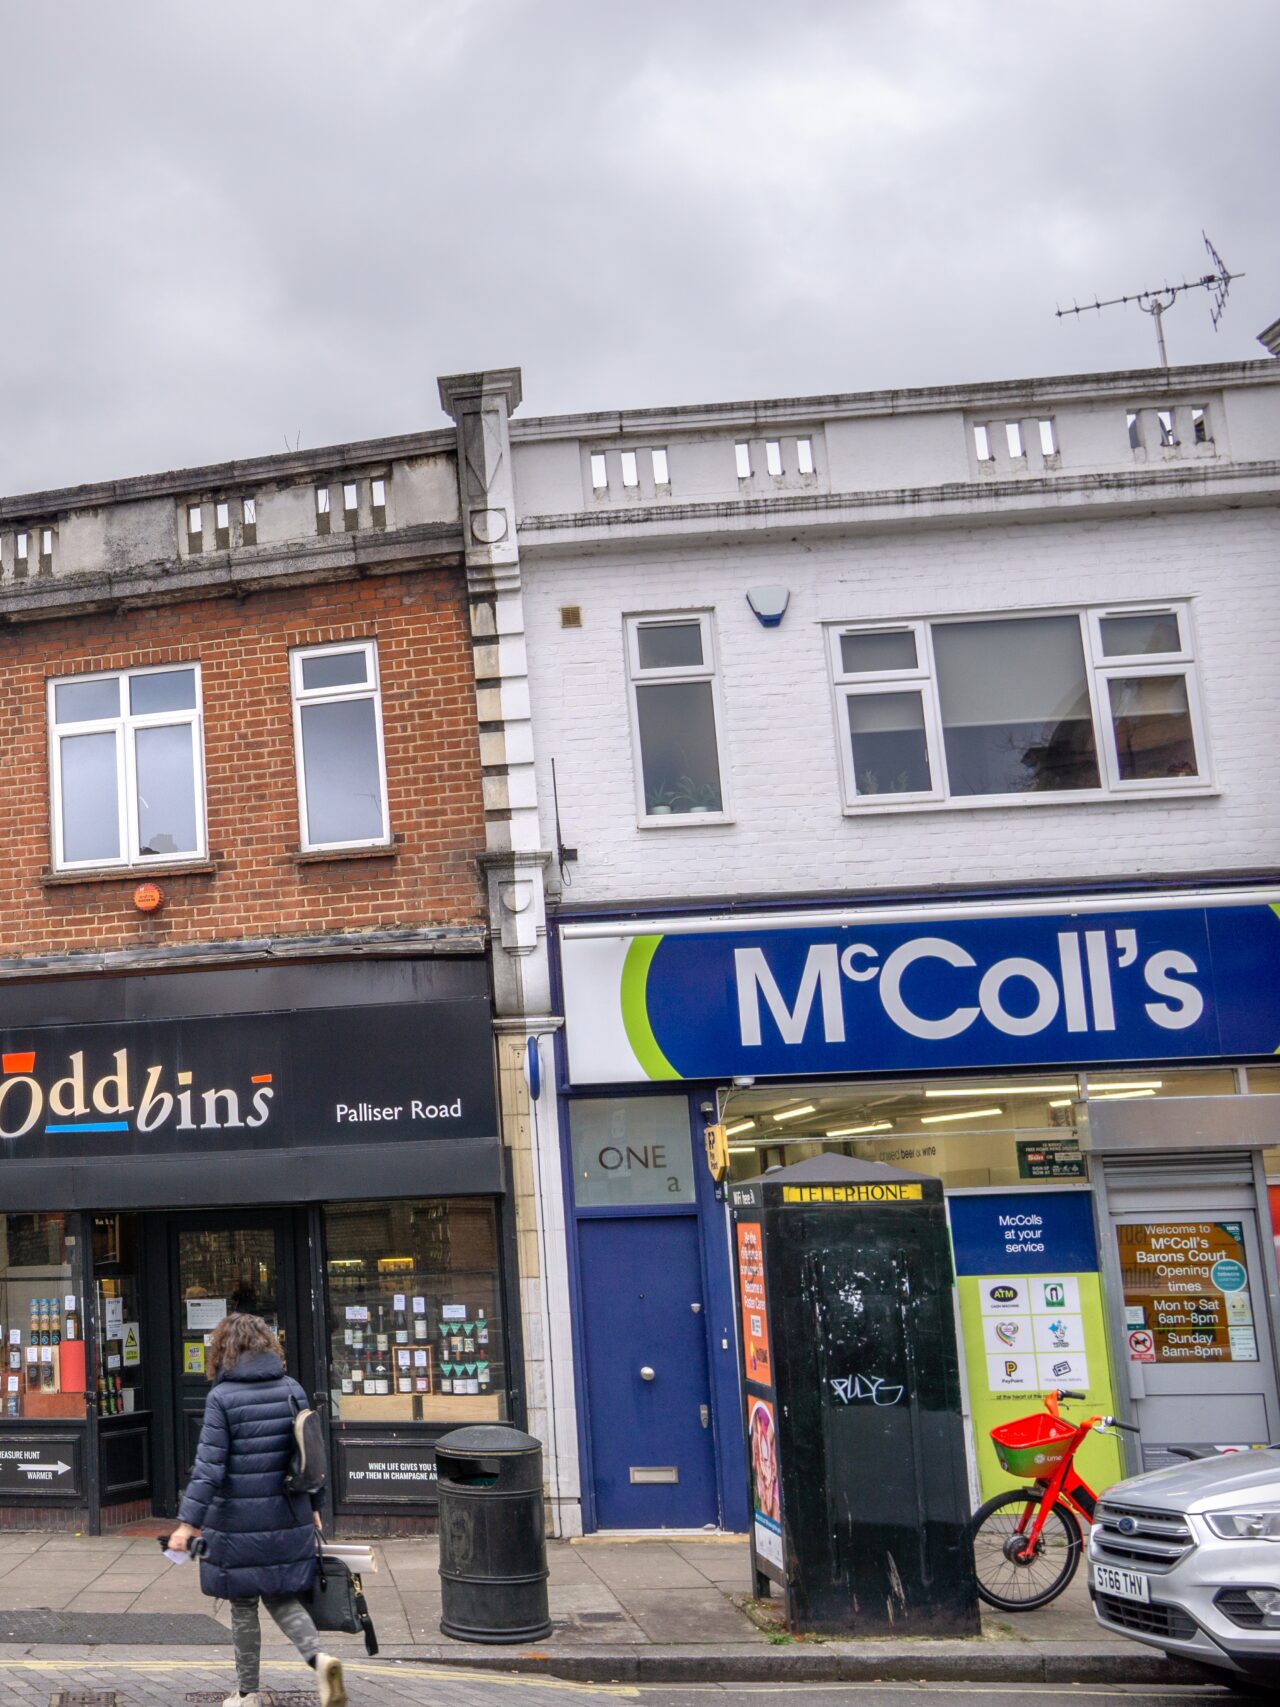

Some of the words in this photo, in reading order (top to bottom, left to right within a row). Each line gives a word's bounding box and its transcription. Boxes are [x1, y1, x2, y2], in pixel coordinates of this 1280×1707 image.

[734, 928, 1205, 1047] McColl's
[336, 1103, 403, 1123] Palliser
[411, 1098, 462, 1119] Road
[598, 1145, 667, 1170] ONE
[901, 1148, 915, 1160] beer
[667, 1176, 681, 1193] a
[798, 1184, 910, 1201] TELEPHONE
[999, 1214, 1043, 1226] McColls
[1005, 1229, 1016, 1239] at
[1018, 1230, 1042, 1241] your
[1145, 1225, 1197, 1235] Welcome
[1199, 1225, 1211, 1233] to
[1006, 1242, 1044, 1252] service
[1151, 1237, 1209, 1250] McColl's
[1136, 1251, 1185, 1263] Barons
[1188, 1250, 1227, 1261] Court
[1156, 1265, 1209, 1278] Opening
[1168, 1281, 1202, 1291] times
[994, 1290, 1014, 1298] ATM
[1154, 1300, 1180, 1310] Mon
[1184, 1300, 1196, 1310] to
[1199, 1299, 1219, 1310] Sat
[1158, 1313, 1219, 1326] 6am-8pm
[1167, 1333, 1213, 1345] Sunday
[1162, 1346, 1222, 1359] 8am-8pm
[24, 1451, 40, 1460] HUNT
[368, 1462, 386, 1471] WHEN
[387, 1462, 399, 1471] LIFE
[400, 1463, 417, 1471] GIVES
[418, 1463, 432, 1471] YOU
[27, 1471, 53, 1480] WARMER
[349, 1471, 365, 1479] PLOP
[366, 1472, 382, 1480] THEM
[383, 1472, 390, 1480] IN
[391, 1472, 428, 1480] CHAMPAGNE
[429, 1472, 438, 1480] AN
[1098, 1567, 1121, 1591] ST66
[1122, 1572, 1142, 1596] THV
